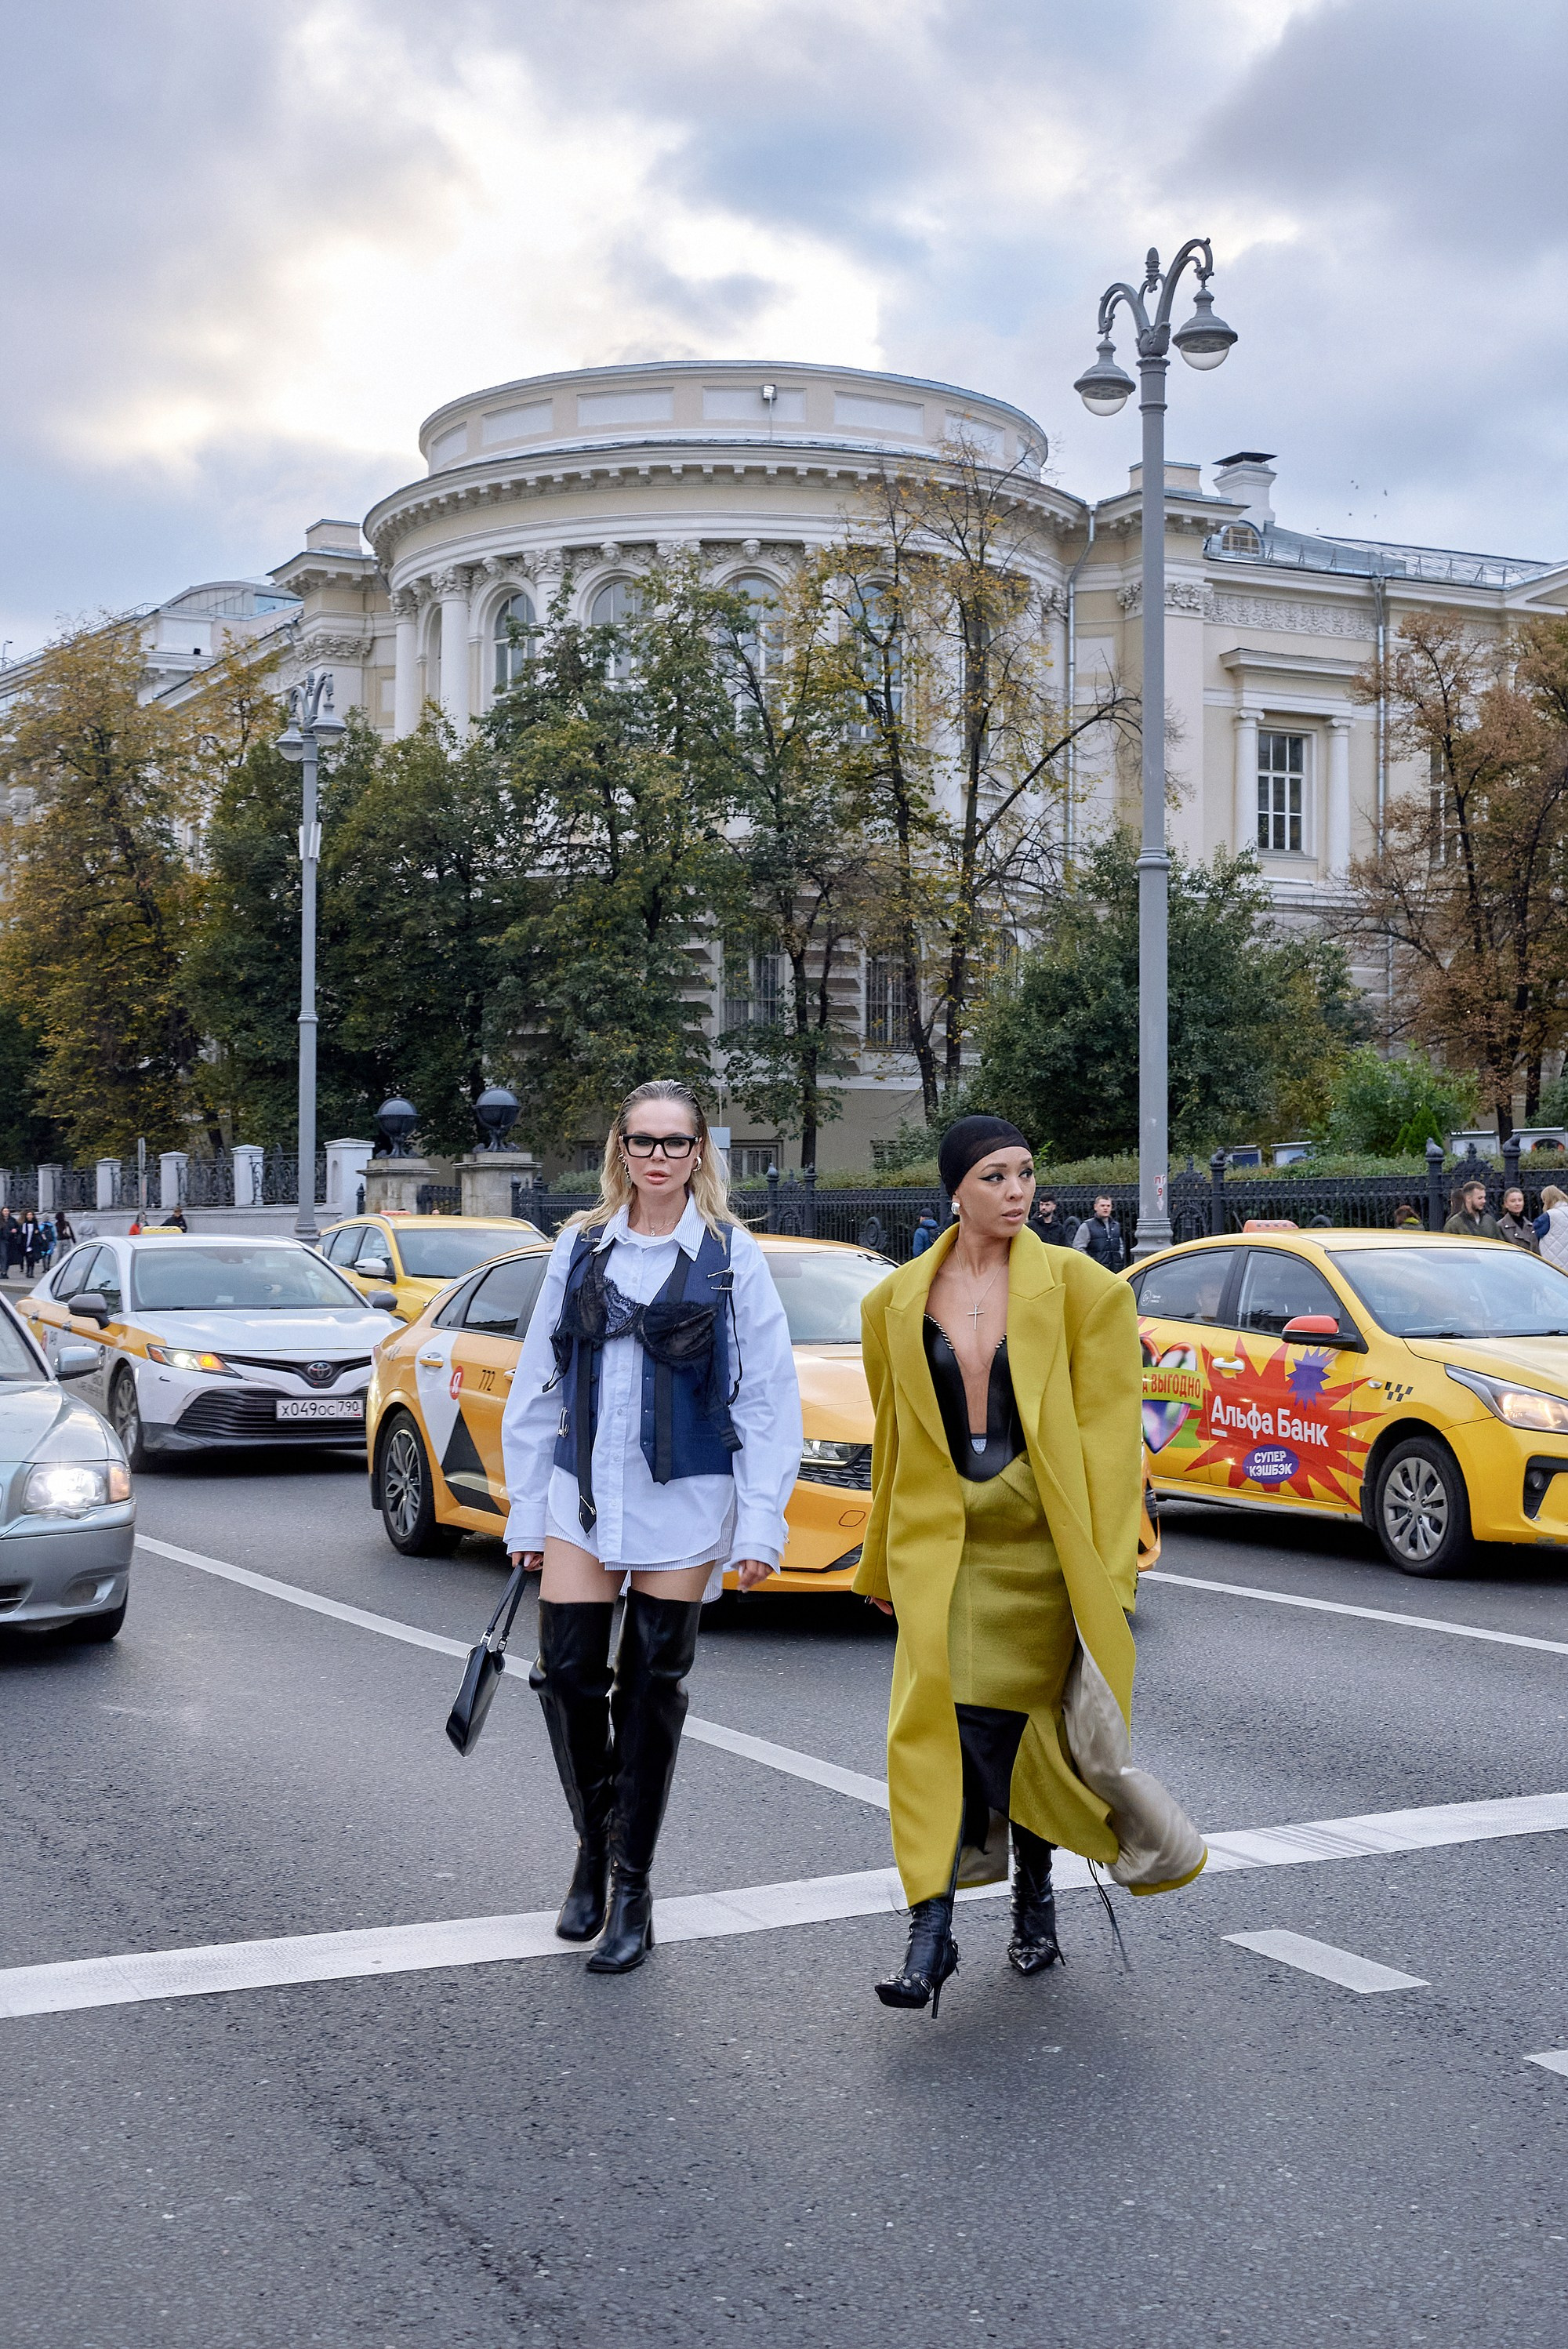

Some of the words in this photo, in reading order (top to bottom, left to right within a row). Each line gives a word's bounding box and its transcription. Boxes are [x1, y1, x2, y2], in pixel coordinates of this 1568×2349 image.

[1157, 1187, 1163, 1196] 9
[478, 1369, 495, 1392] 772
[1151, 1374, 1201, 1399] ВЫГОДНО
[338, 1400, 359, 1412] 790
[1210, 1396, 1274, 1440] Альфа
[1277, 1407, 1330, 1447] Банк
[1254, 1451, 1287, 1464] СУПЕР
[1249, 1463, 1293, 1476] КЭШБЭК
